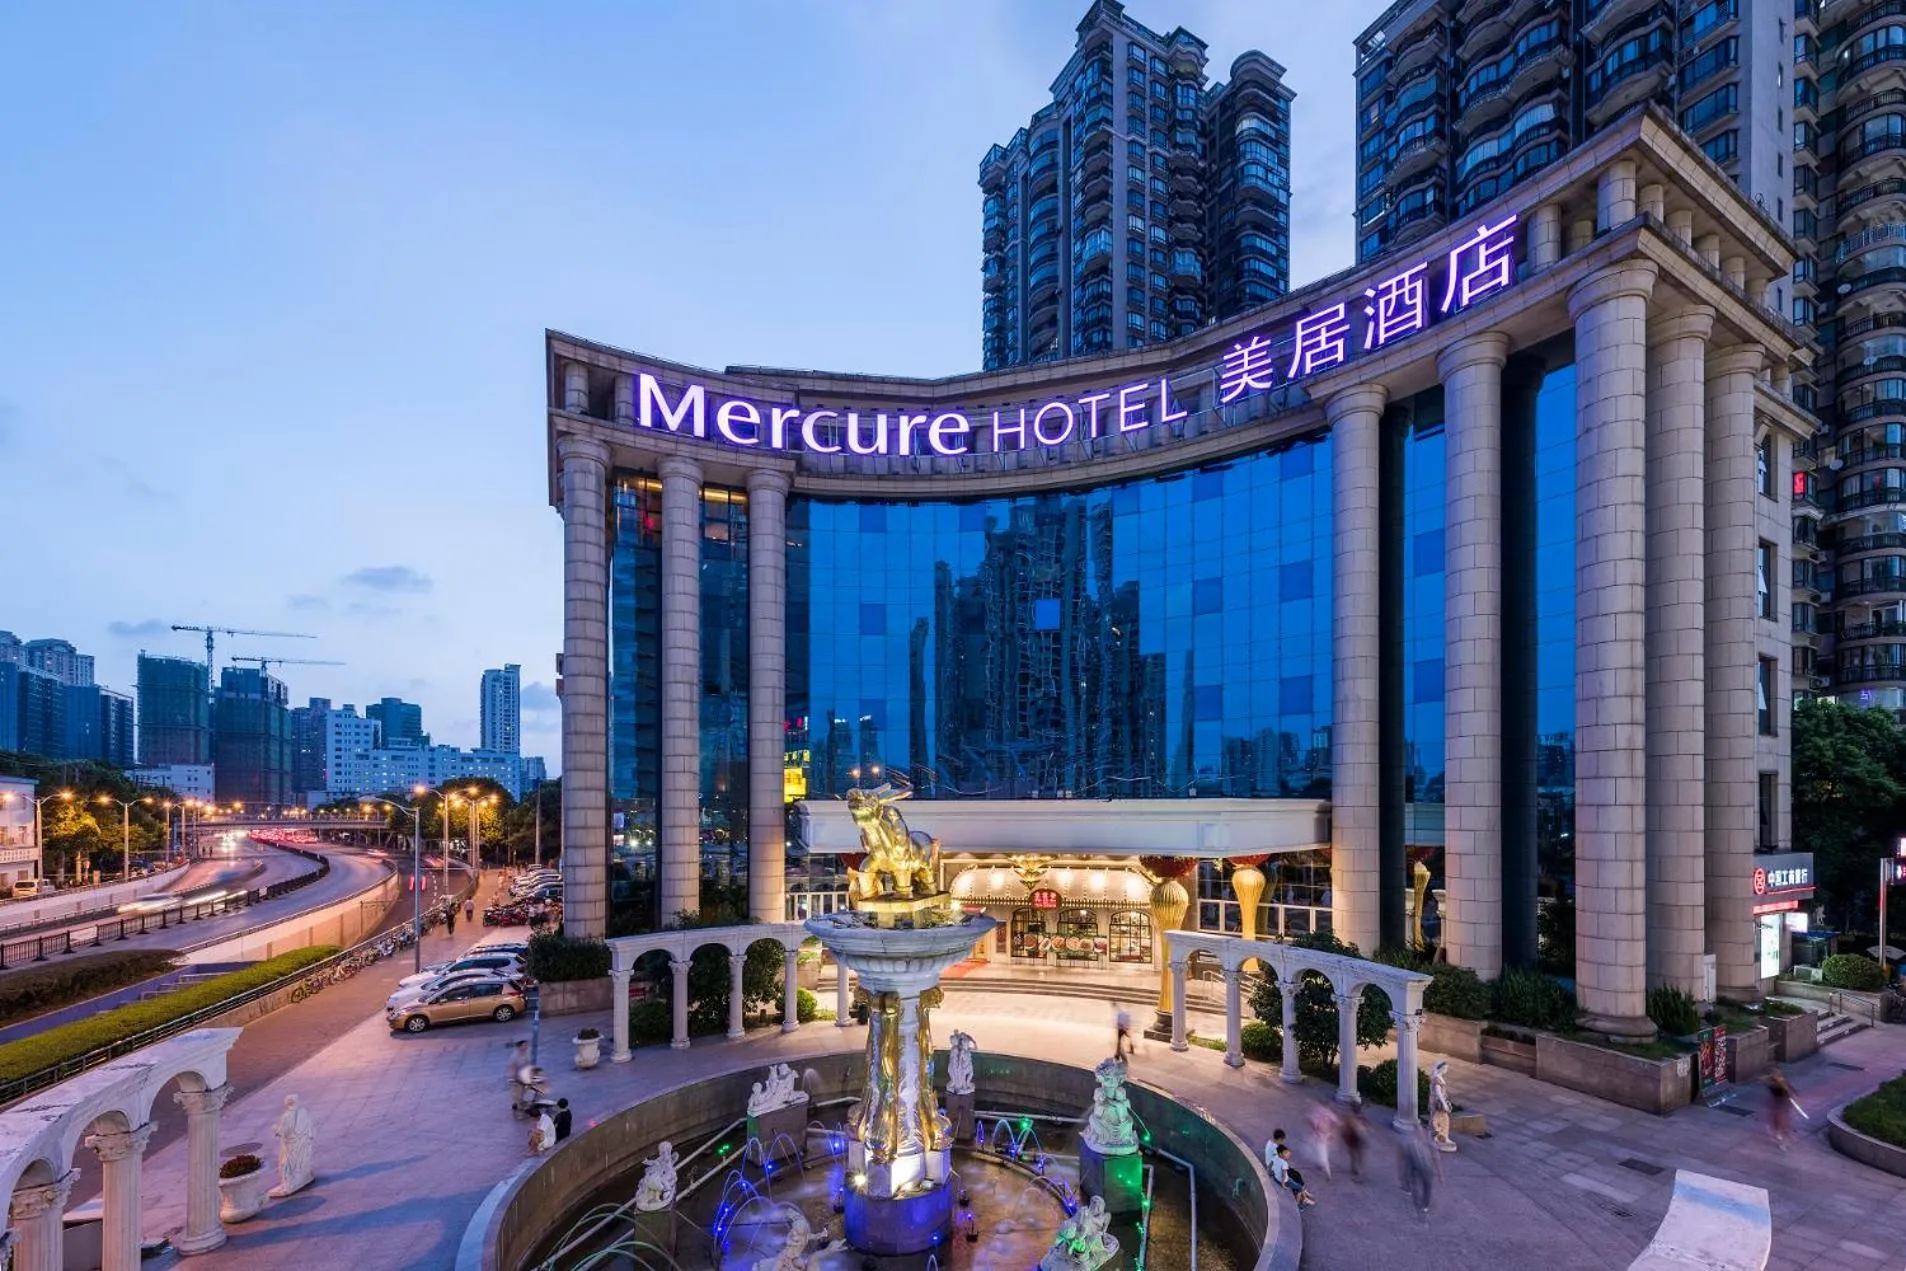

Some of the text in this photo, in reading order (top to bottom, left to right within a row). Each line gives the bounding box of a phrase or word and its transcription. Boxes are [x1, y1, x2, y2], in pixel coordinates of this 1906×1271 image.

[1220, 214, 1518, 404] 美居酒店
[638, 373, 1188, 456] Mercure HOTEL
